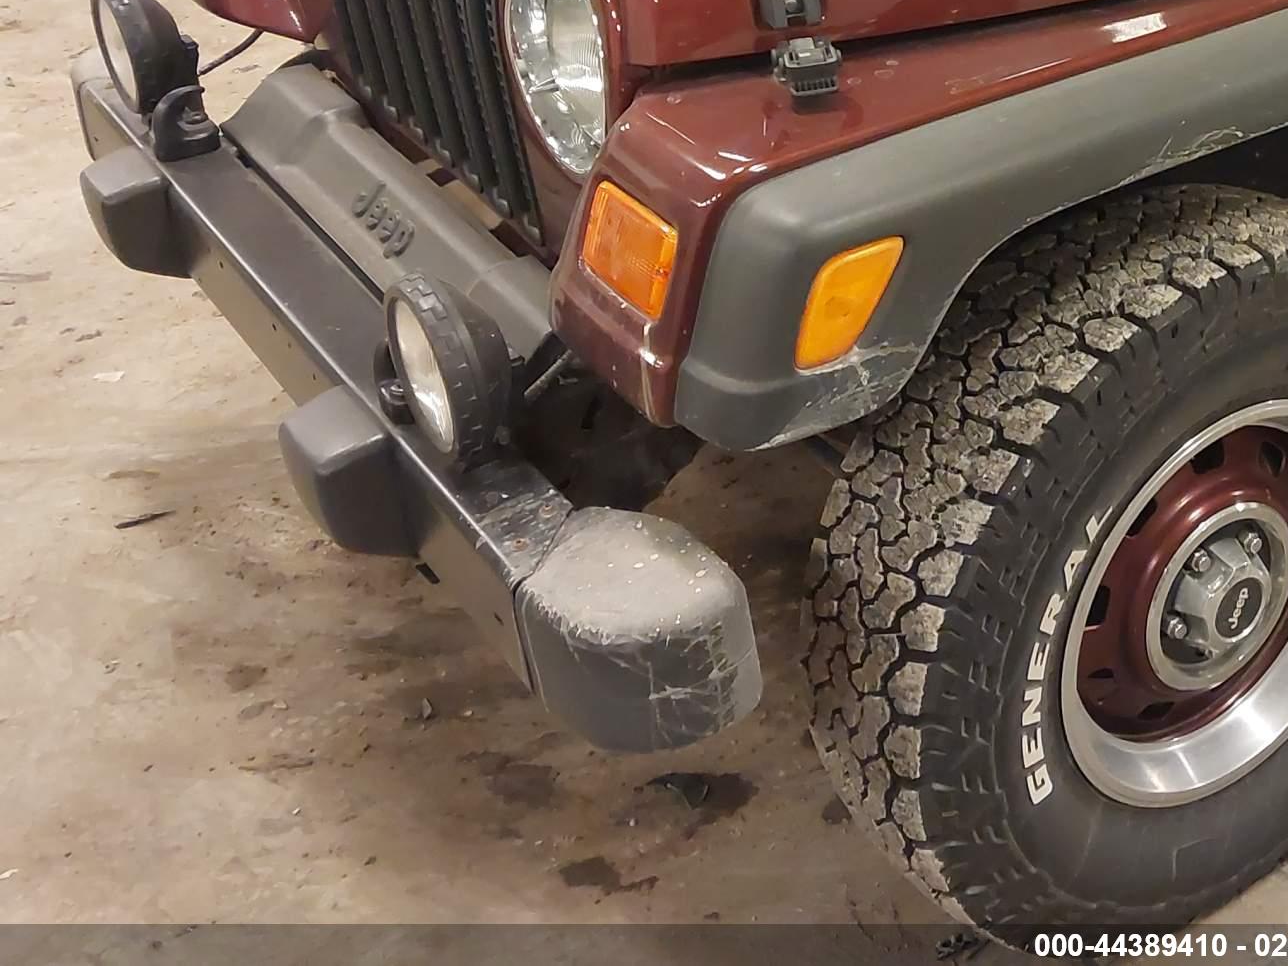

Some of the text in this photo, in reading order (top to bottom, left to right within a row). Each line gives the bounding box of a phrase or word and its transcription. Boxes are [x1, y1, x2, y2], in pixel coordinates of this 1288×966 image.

[352, 180, 415, 259] Jeep
[1228, 587, 1249, 630] Jeep
[1021, 506, 1114, 805] GENERAL
